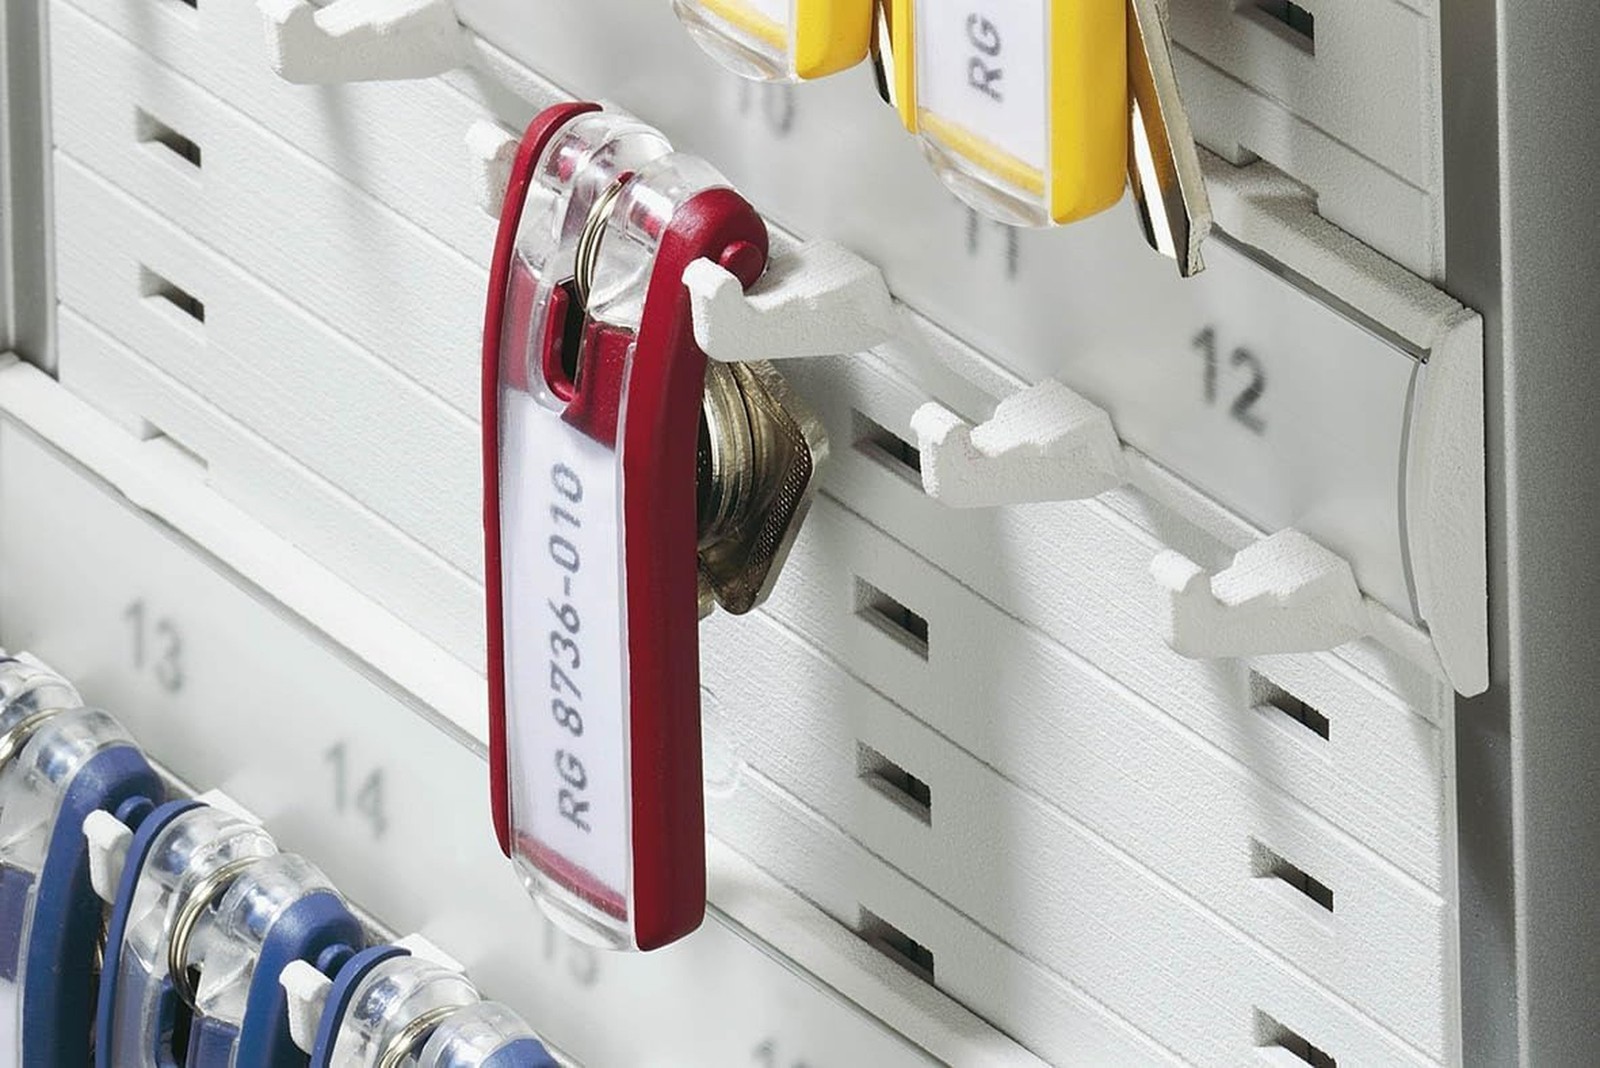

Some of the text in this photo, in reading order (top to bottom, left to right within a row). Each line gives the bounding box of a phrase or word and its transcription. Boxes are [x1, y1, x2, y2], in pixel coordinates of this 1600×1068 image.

[966, 12, 1004, 102] RG
[1190, 323, 1268, 437] 12
[121, 597, 187, 697] 13
[548, 462, 592, 833] RG 8736-010
[322, 740, 389, 839] 14
